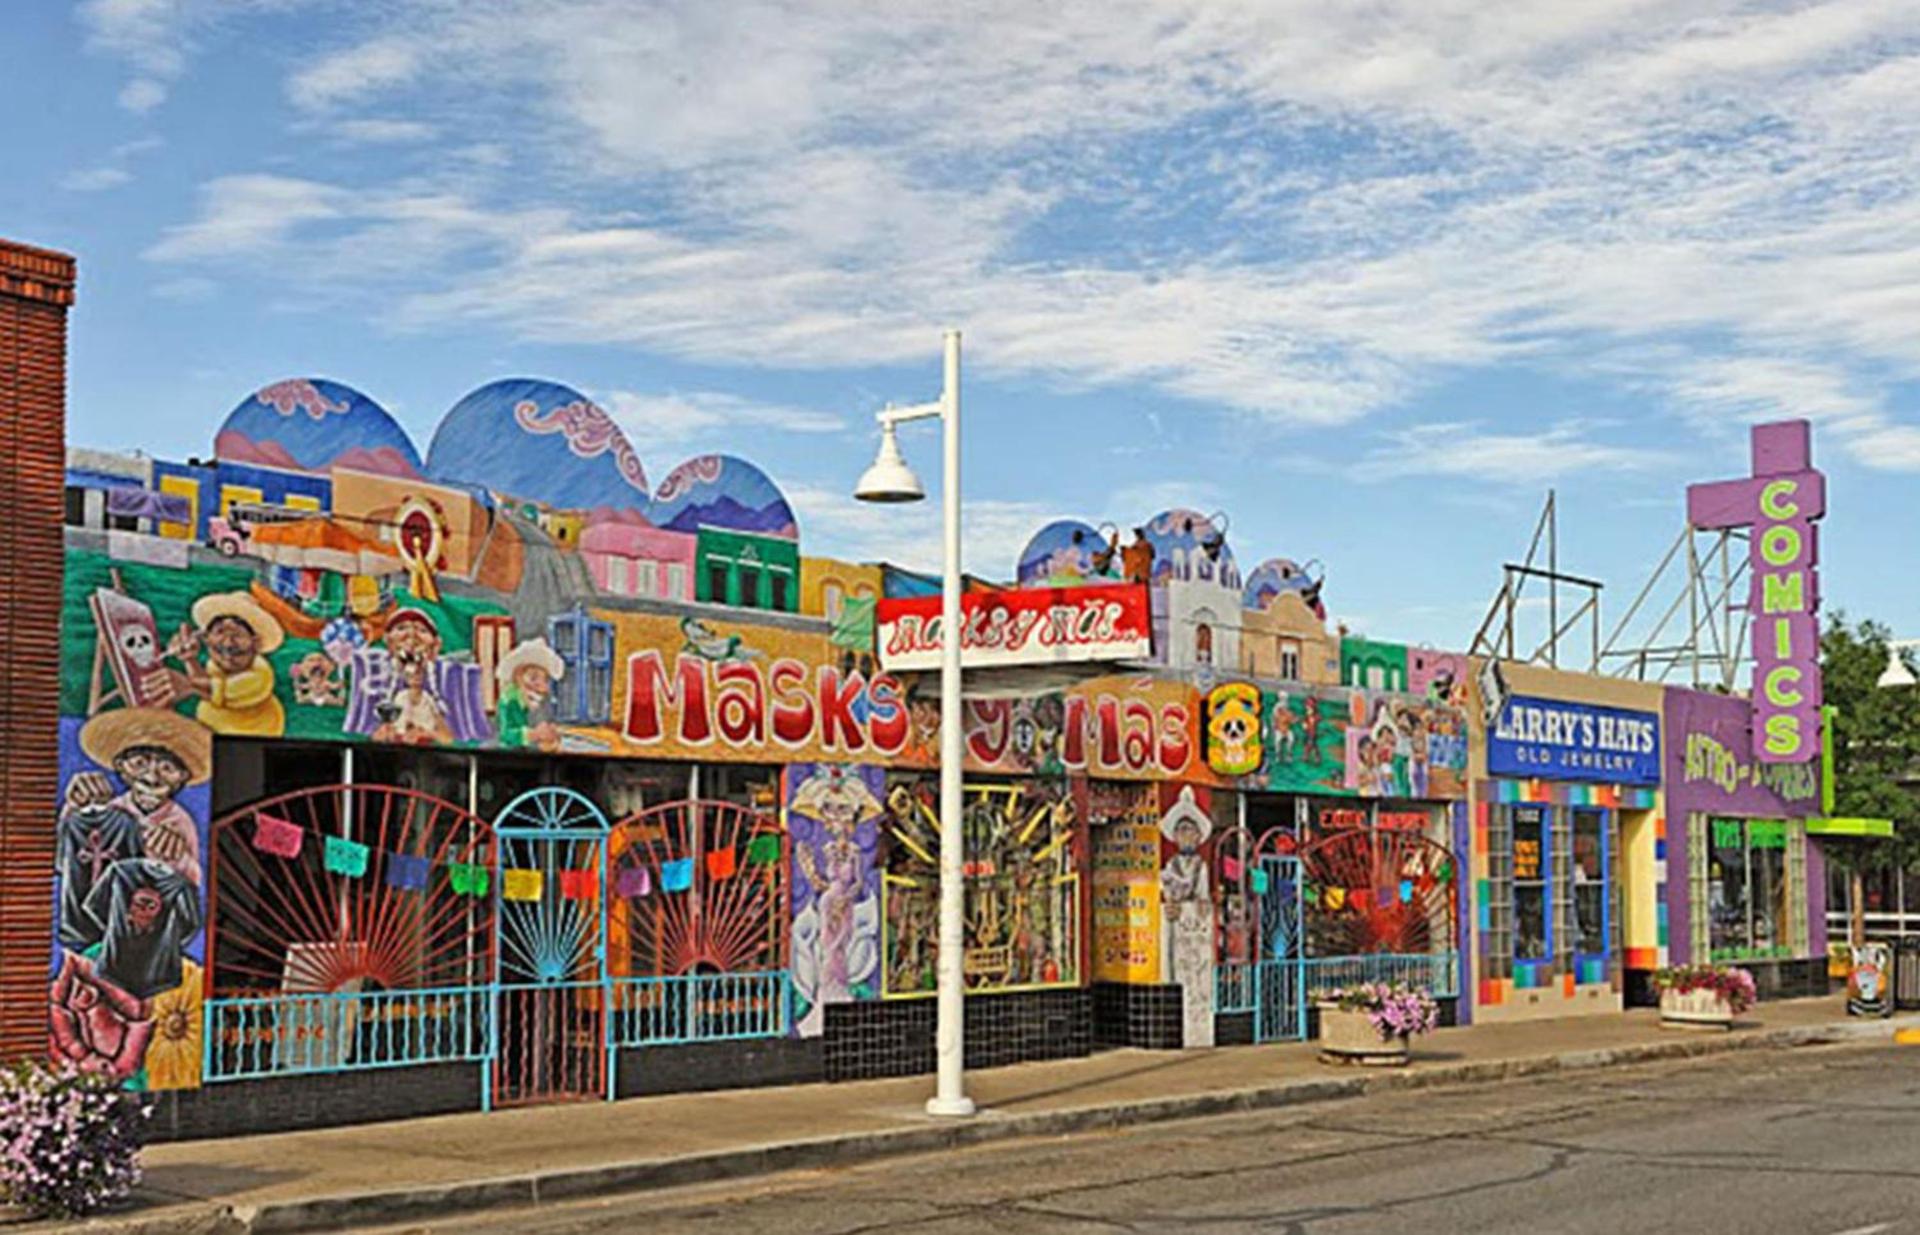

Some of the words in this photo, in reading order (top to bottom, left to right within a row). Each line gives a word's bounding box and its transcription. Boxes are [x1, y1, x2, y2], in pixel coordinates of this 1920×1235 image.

[1760, 480, 1803, 755] COMICS
[1495, 705, 1595, 748] LARRY'S
[1597, 715, 1655, 754] HATS
[1516, 746, 1551, 764] OLD
[1560, 751, 1636, 771] JEWELRY
